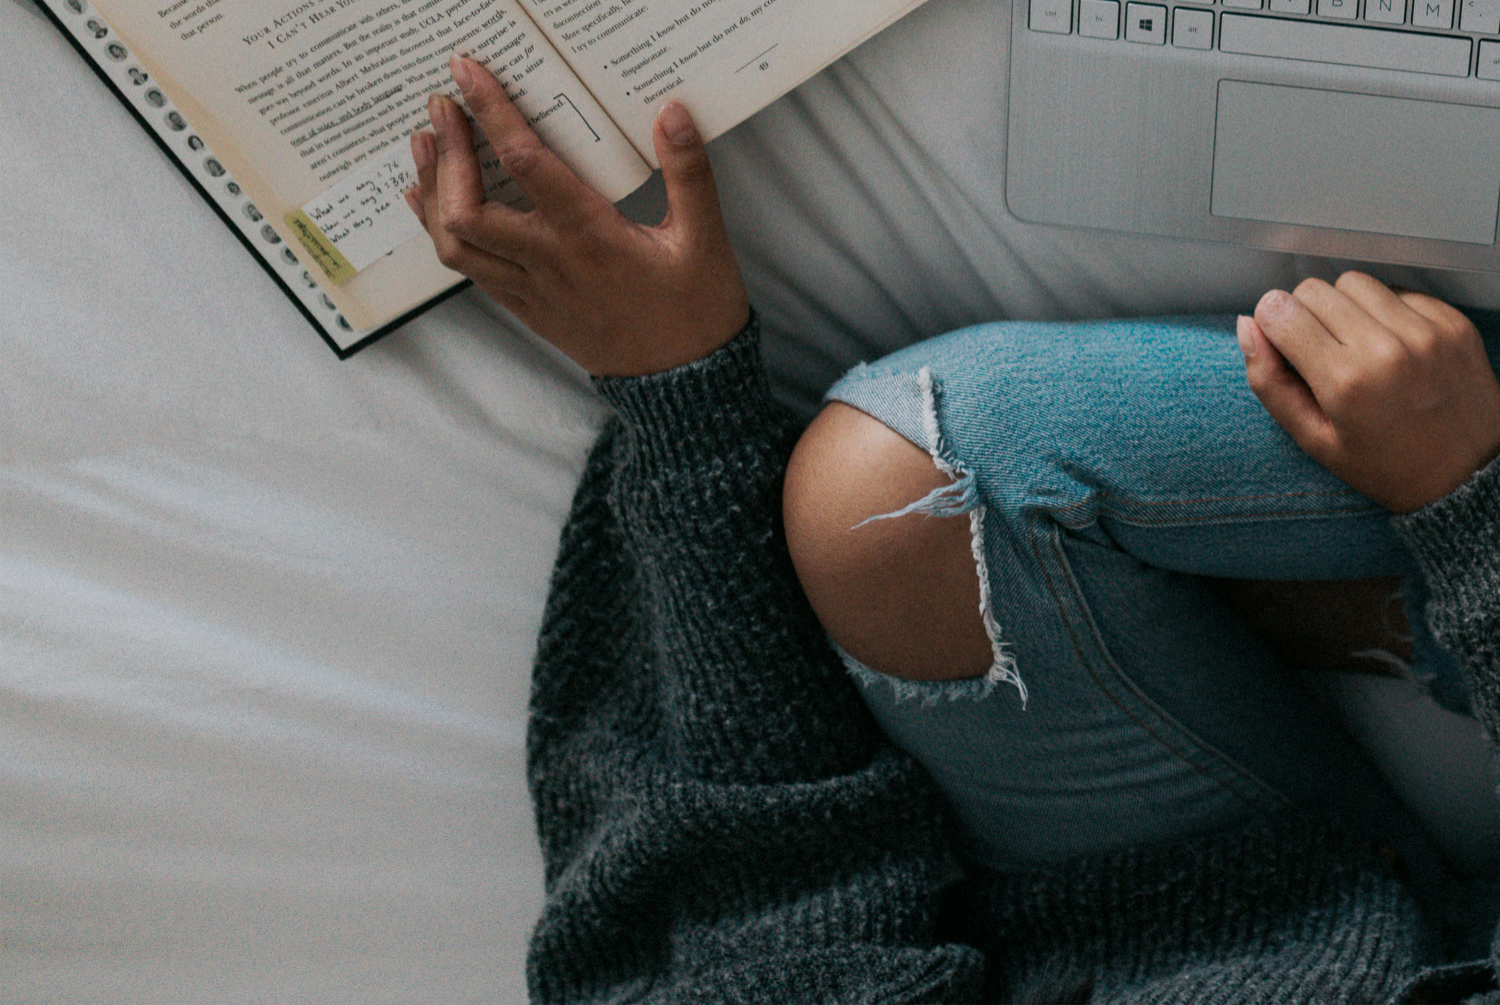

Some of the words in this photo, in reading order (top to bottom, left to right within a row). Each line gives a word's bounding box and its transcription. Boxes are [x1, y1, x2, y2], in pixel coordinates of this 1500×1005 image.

[241, 26, 273, 47] YOUR
[272, 0, 316, 30] ACTIONS
[266, 40, 276, 50] I
[275, 21, 308, 44] CAN'T
[307, 5, 337, 25] HEAR
[1425, 2, 1440, 17] M
[758, 61, 770, 72] 49
[309, 202, 333, 220] What
[337, 194, 350, 205] we
[355, 180, 374, 190] say
[319, 220, 338, 233] How
[342, 208, 357, 220] we
[360, 195, 378, 206] say
